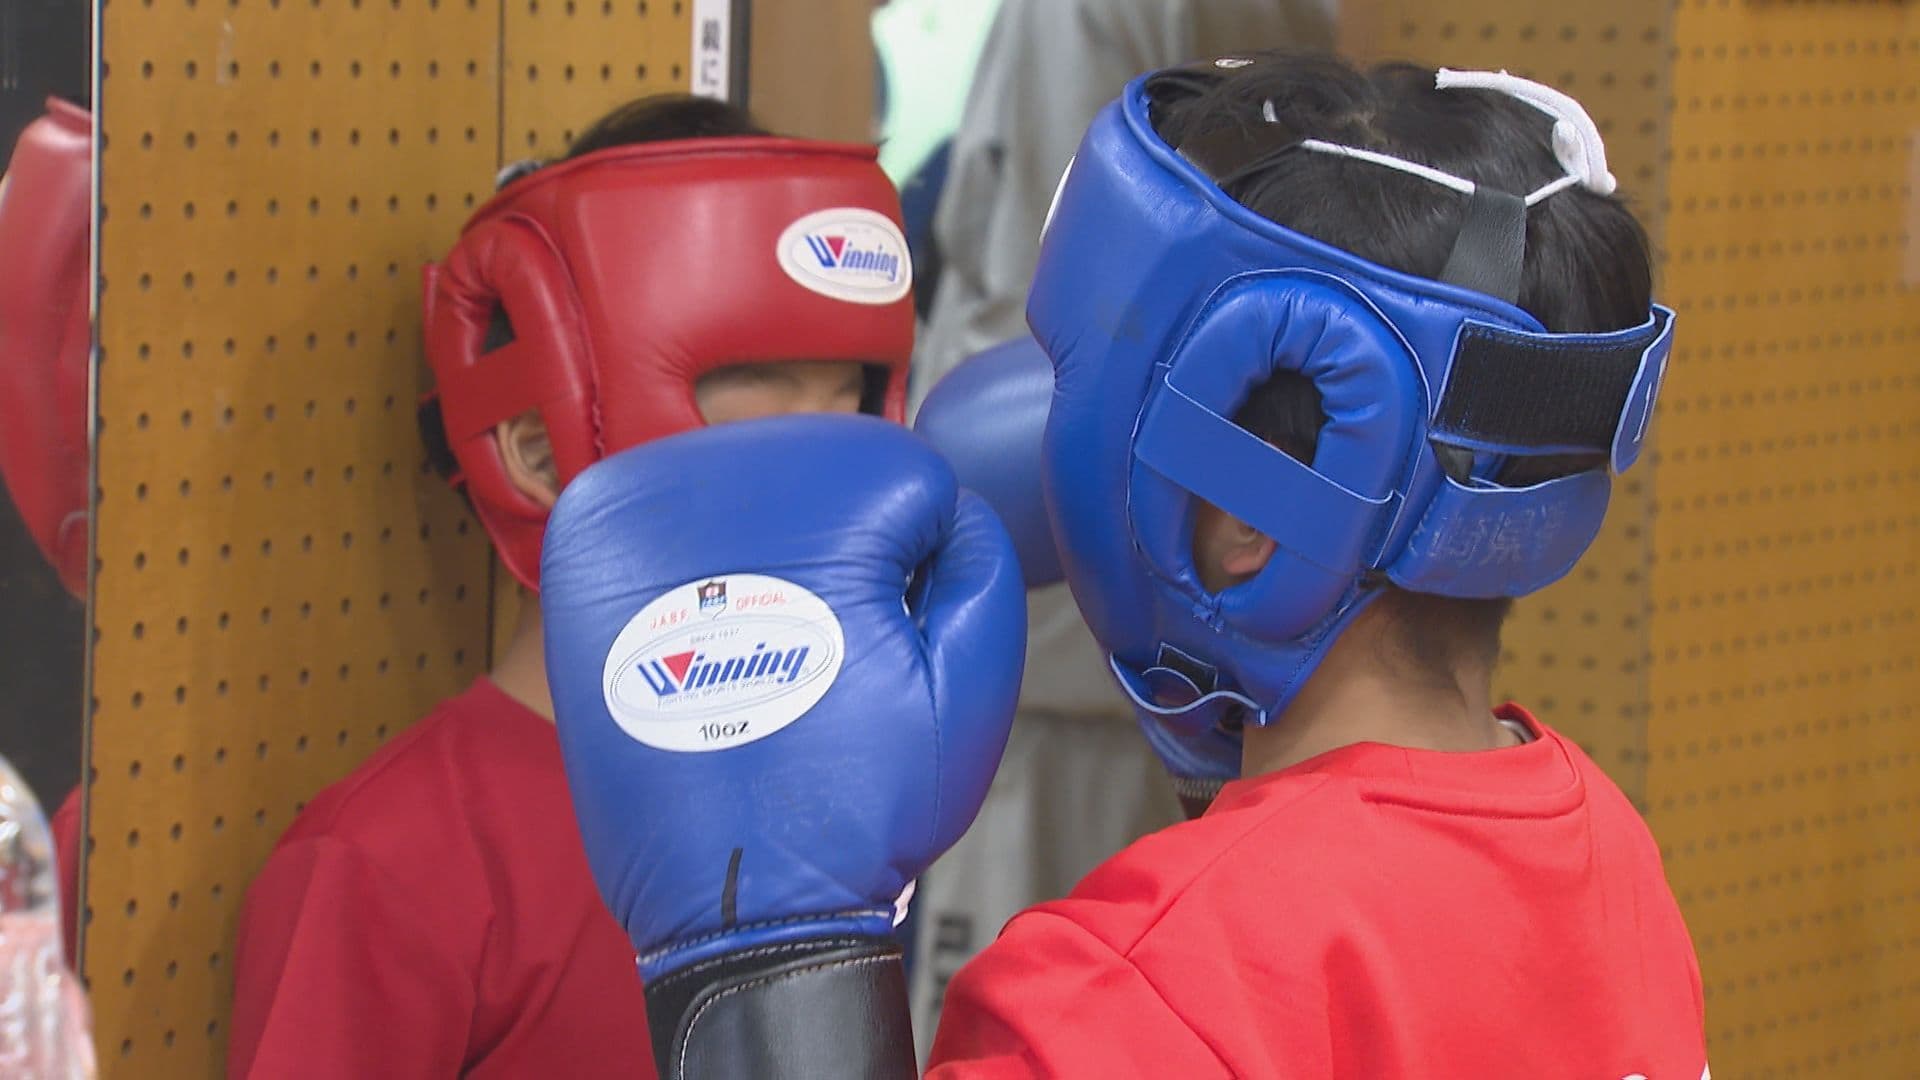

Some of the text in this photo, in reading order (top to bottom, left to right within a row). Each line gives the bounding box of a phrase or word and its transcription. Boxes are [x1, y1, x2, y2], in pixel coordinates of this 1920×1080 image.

[804, 234, 898, 282] Winning
[736, 591, 786, 610] OFFICIAL
[637, 642, 810, 696] Winning
